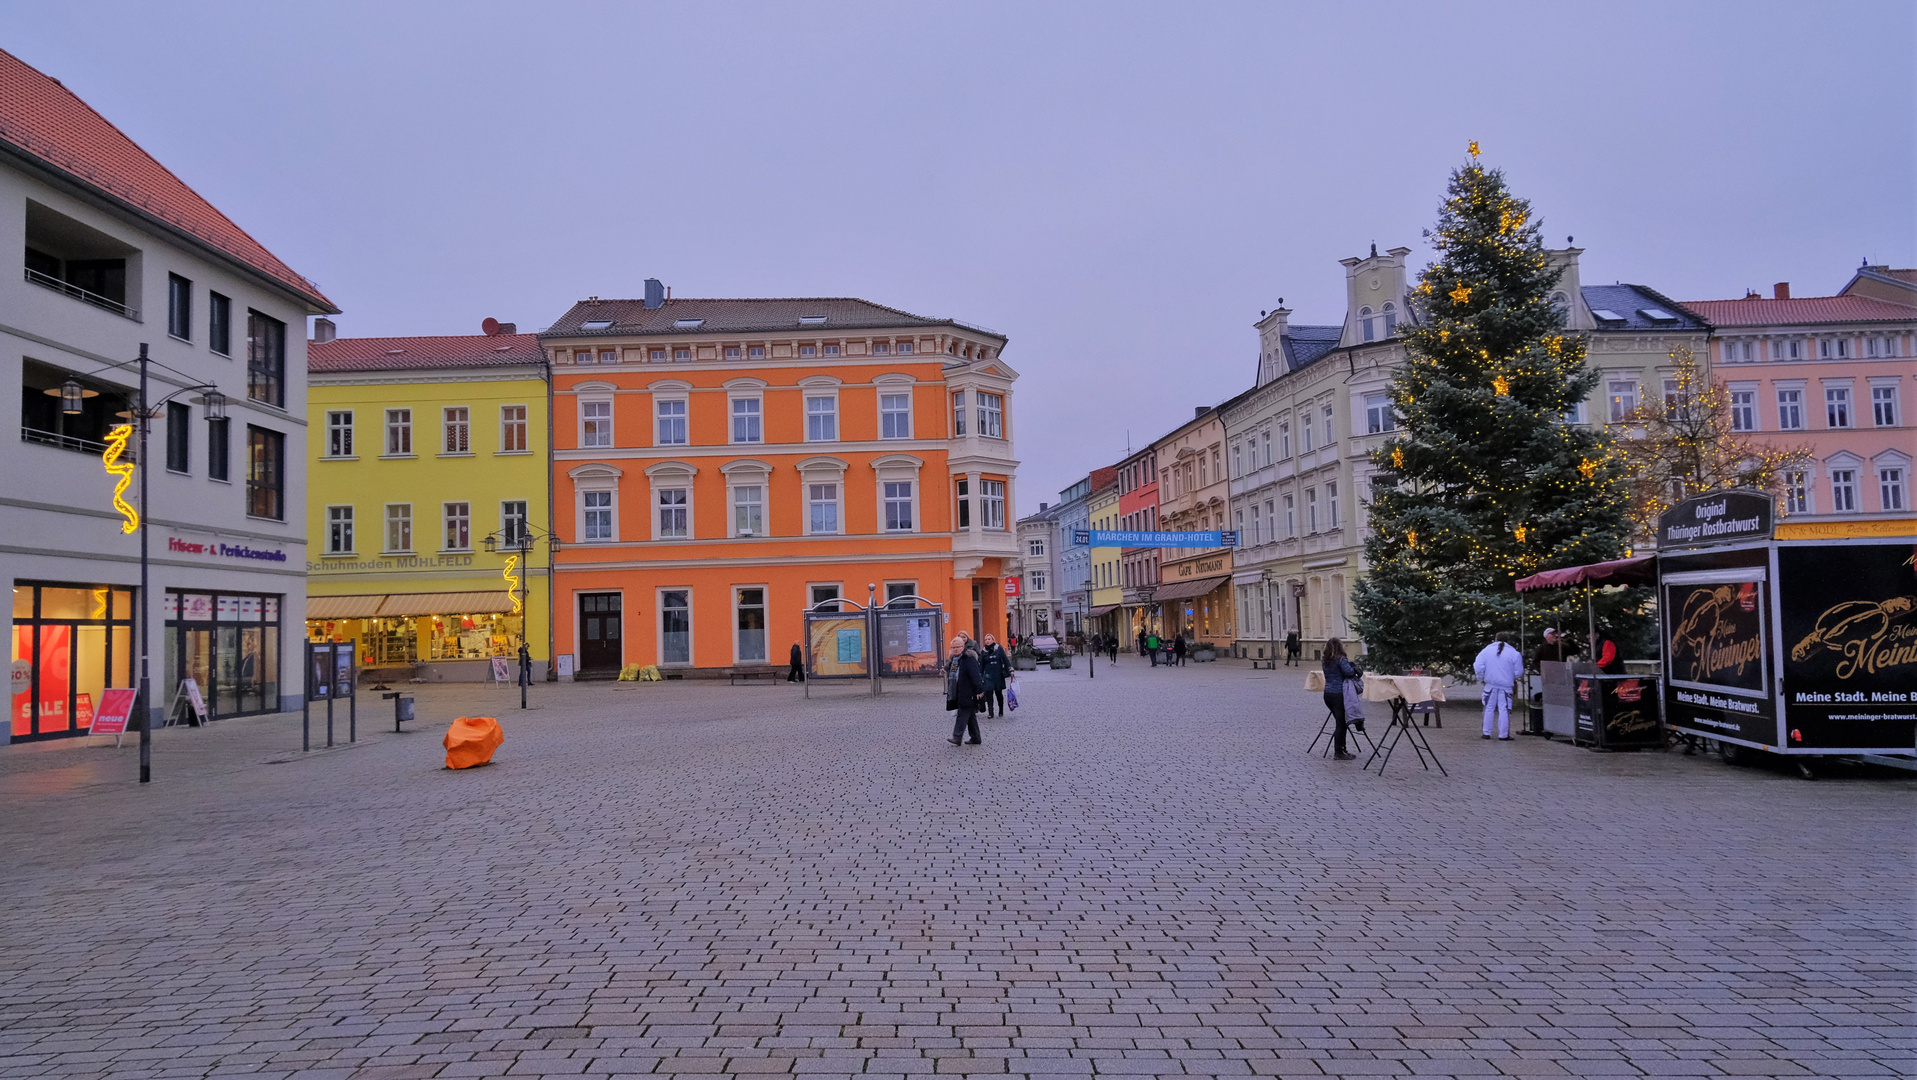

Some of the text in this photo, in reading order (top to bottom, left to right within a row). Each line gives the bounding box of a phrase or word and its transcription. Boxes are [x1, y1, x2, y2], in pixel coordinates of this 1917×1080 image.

[1695, 499, 1726, 521] Original
[1097, 531, 1213, 541] MÄRCHEN IM GRAND-HOTEL
[1667, 515, 1760, 541] Thüringer Rostbratwurst
[1809, 525, 1840, 535] MODE
[306, 556, 472, 571] Schuhmoden MÜHLFELD
[1691, 633, 1761, 682] Meininger
[1677, 691, 1760, 714] Meine Stadt. Meine Bratwurst.
[1796, 691, 1832, 702] Meine
[1834, 691, 1868, 702] Stadt.
[1871, 691, 1907, 702] Meine
